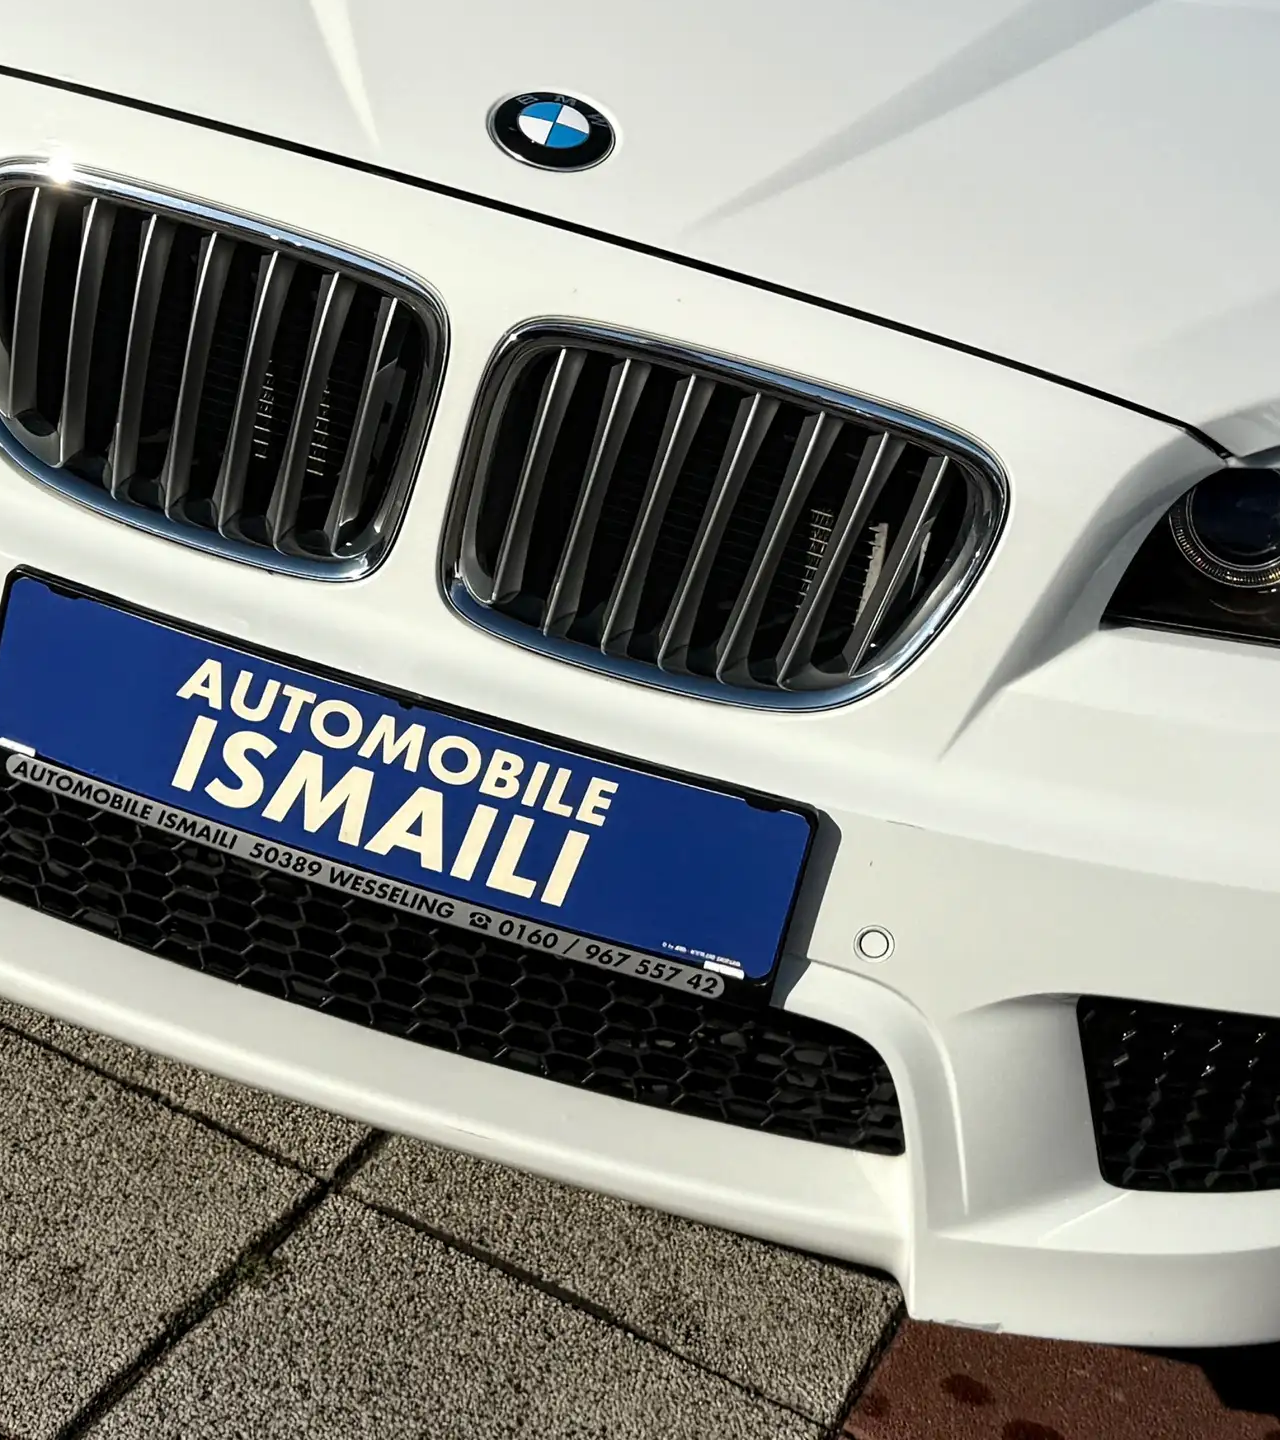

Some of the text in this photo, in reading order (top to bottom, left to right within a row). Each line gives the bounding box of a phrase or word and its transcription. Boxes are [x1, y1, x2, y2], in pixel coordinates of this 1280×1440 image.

[516, 94, 609, 128] BMW
[170, 715, 590, 907] ISMAILI
[176, 658, 619, 827] AUTOMOBILE
[12, 760, 153, 821] AUTOMOBILE
[156, 809, 238, 850] ISMAILI
[249, 842, 323, 877] 50389
[329, 866, 455, 919] WESSELING
[498, 919, 559, 949] 0160
[586, 944, 631, 967] 967
[635, 959, 683, 983] 557
[686, 973, 718, 994] 42
